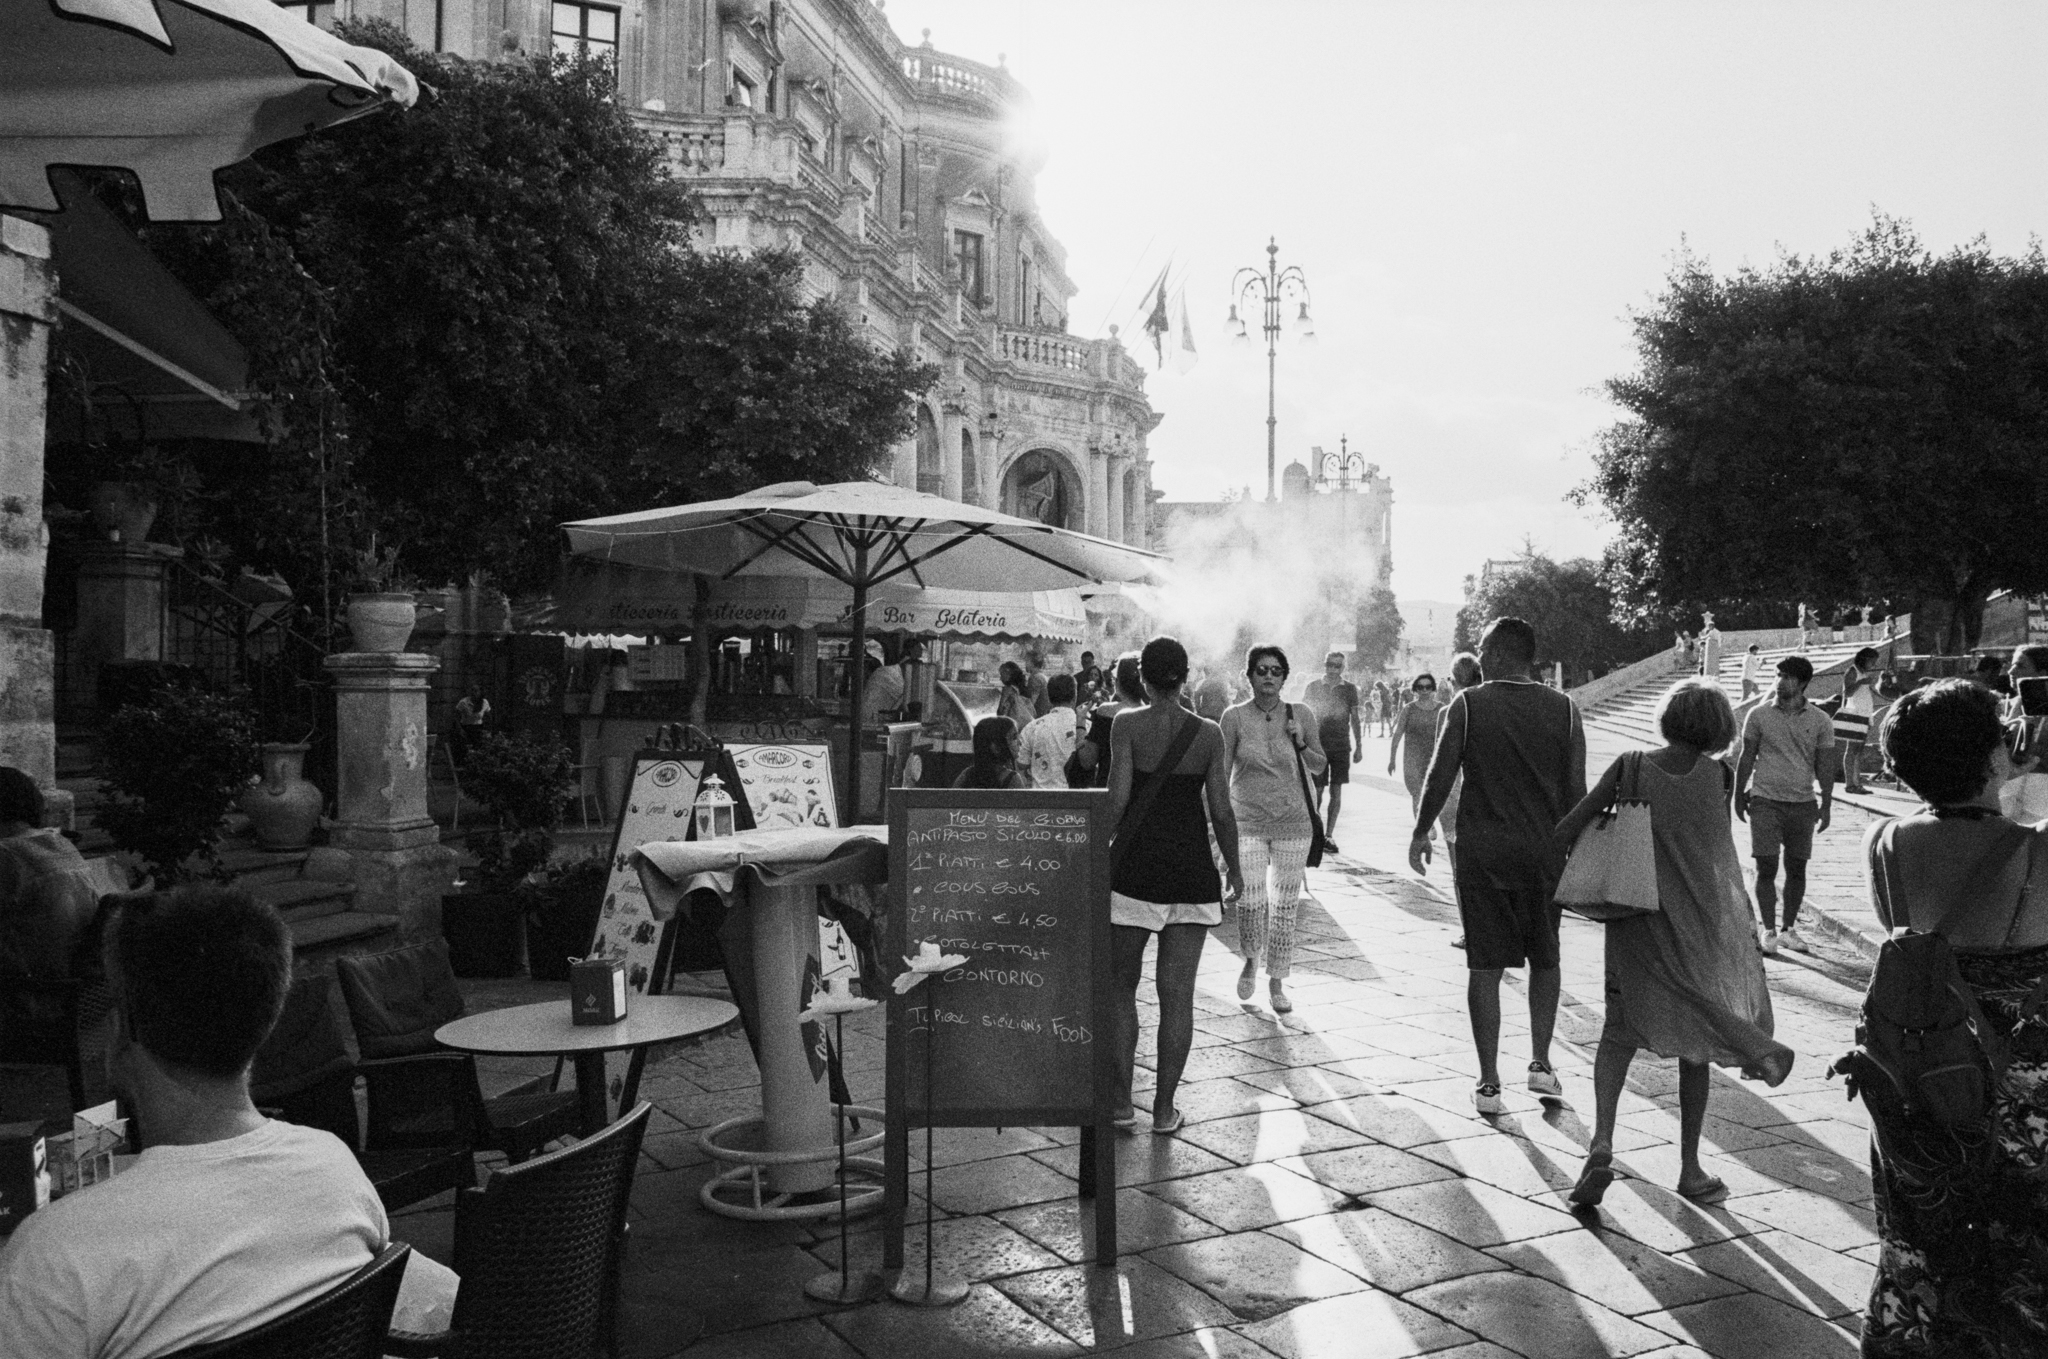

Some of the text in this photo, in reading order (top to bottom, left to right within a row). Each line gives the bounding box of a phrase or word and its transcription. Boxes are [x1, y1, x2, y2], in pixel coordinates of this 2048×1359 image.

[884, 606, 1007, 628] Bar Gelateria
[996, 813, 1021, 824] DEL
[934, 881, 1040, 895] COUS COUS
[944, 967, 1044, 988] CONTORNO
[1052, 1016, 1093, 1044] FOOD
